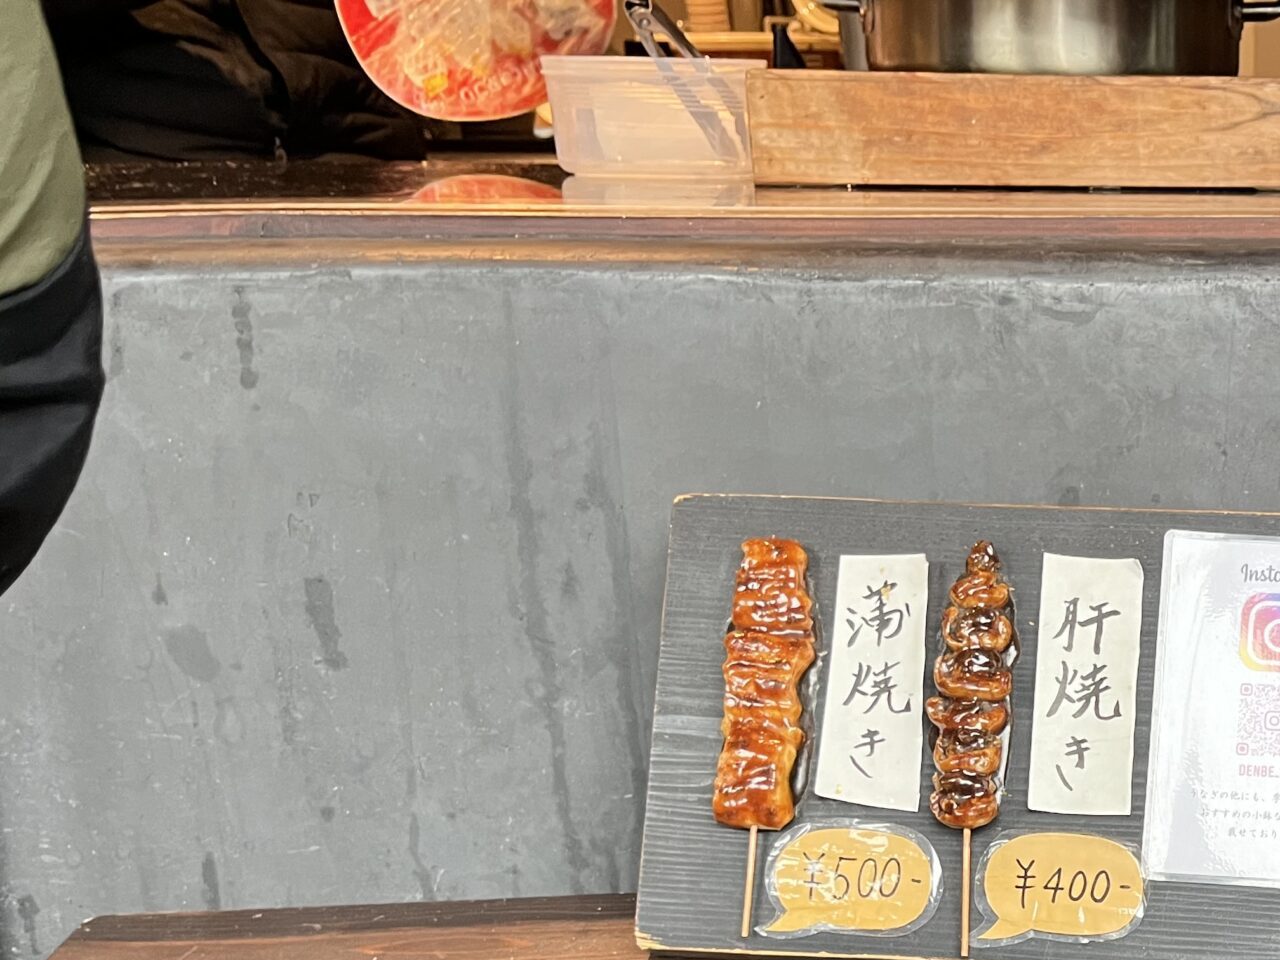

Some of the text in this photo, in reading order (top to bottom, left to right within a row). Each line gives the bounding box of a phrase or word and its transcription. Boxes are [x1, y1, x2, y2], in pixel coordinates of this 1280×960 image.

[842, 580, 912, 779] 蒲焼き
[1045, 597, 1122, 791] 肝焼き
[1015, 858, 1131, 908] ¥400-
